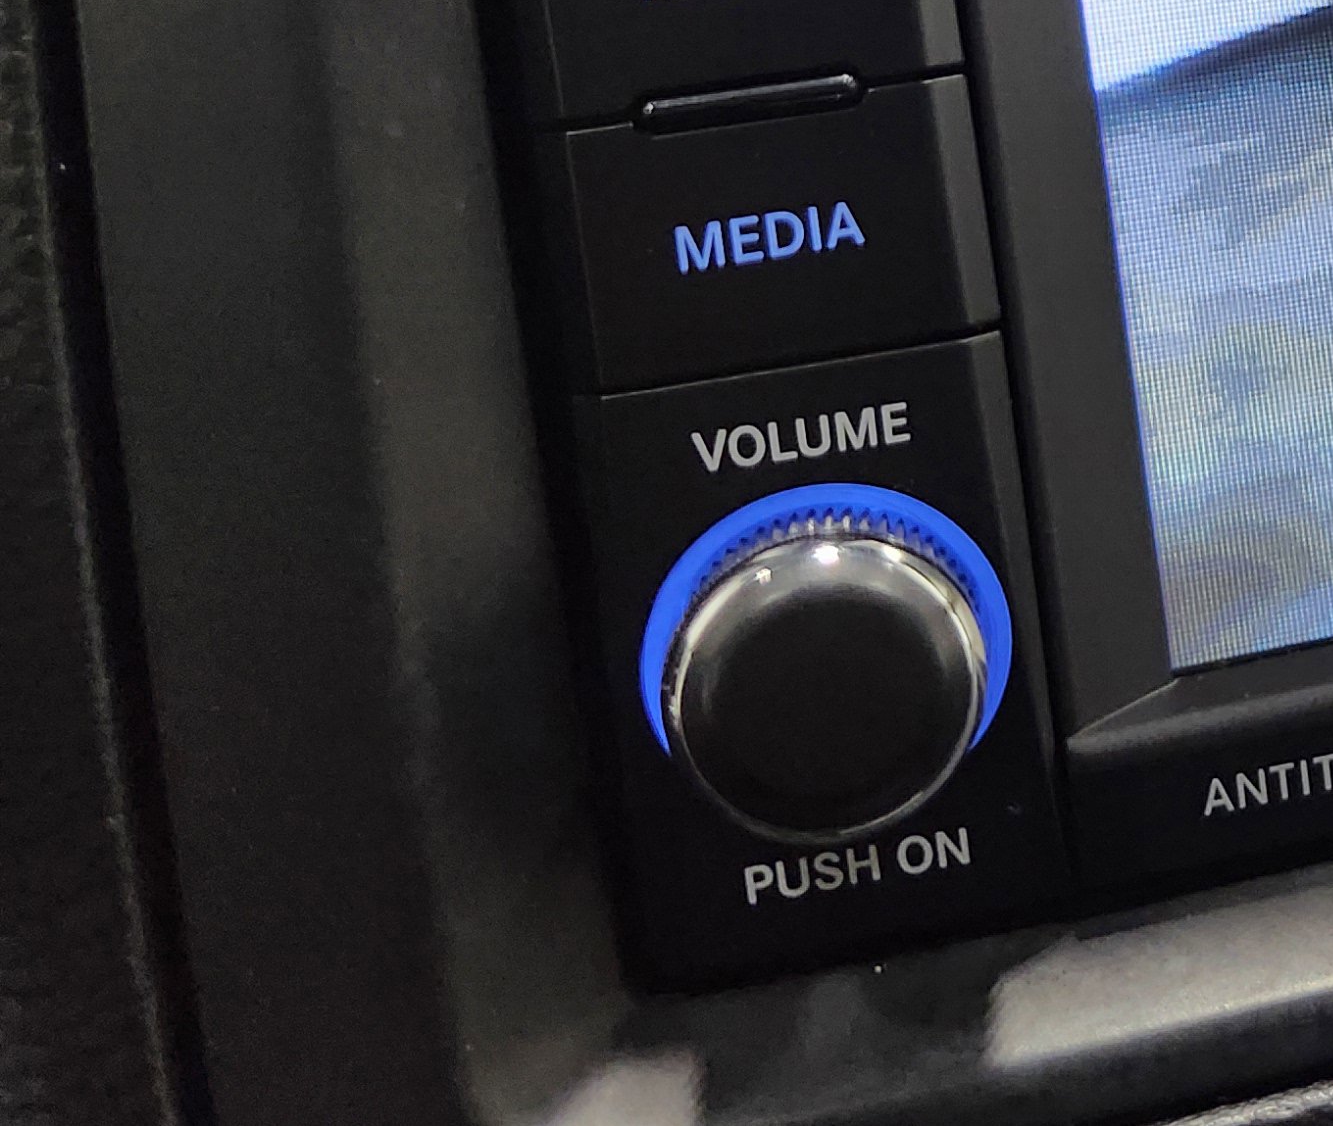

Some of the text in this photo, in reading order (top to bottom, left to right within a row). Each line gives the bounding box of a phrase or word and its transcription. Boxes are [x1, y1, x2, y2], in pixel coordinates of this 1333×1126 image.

[673, 201, 866, 275] MEDIA
[690, 401, 912, 473] VOLUME
[743, 827, 972, 906] PUSH ON
